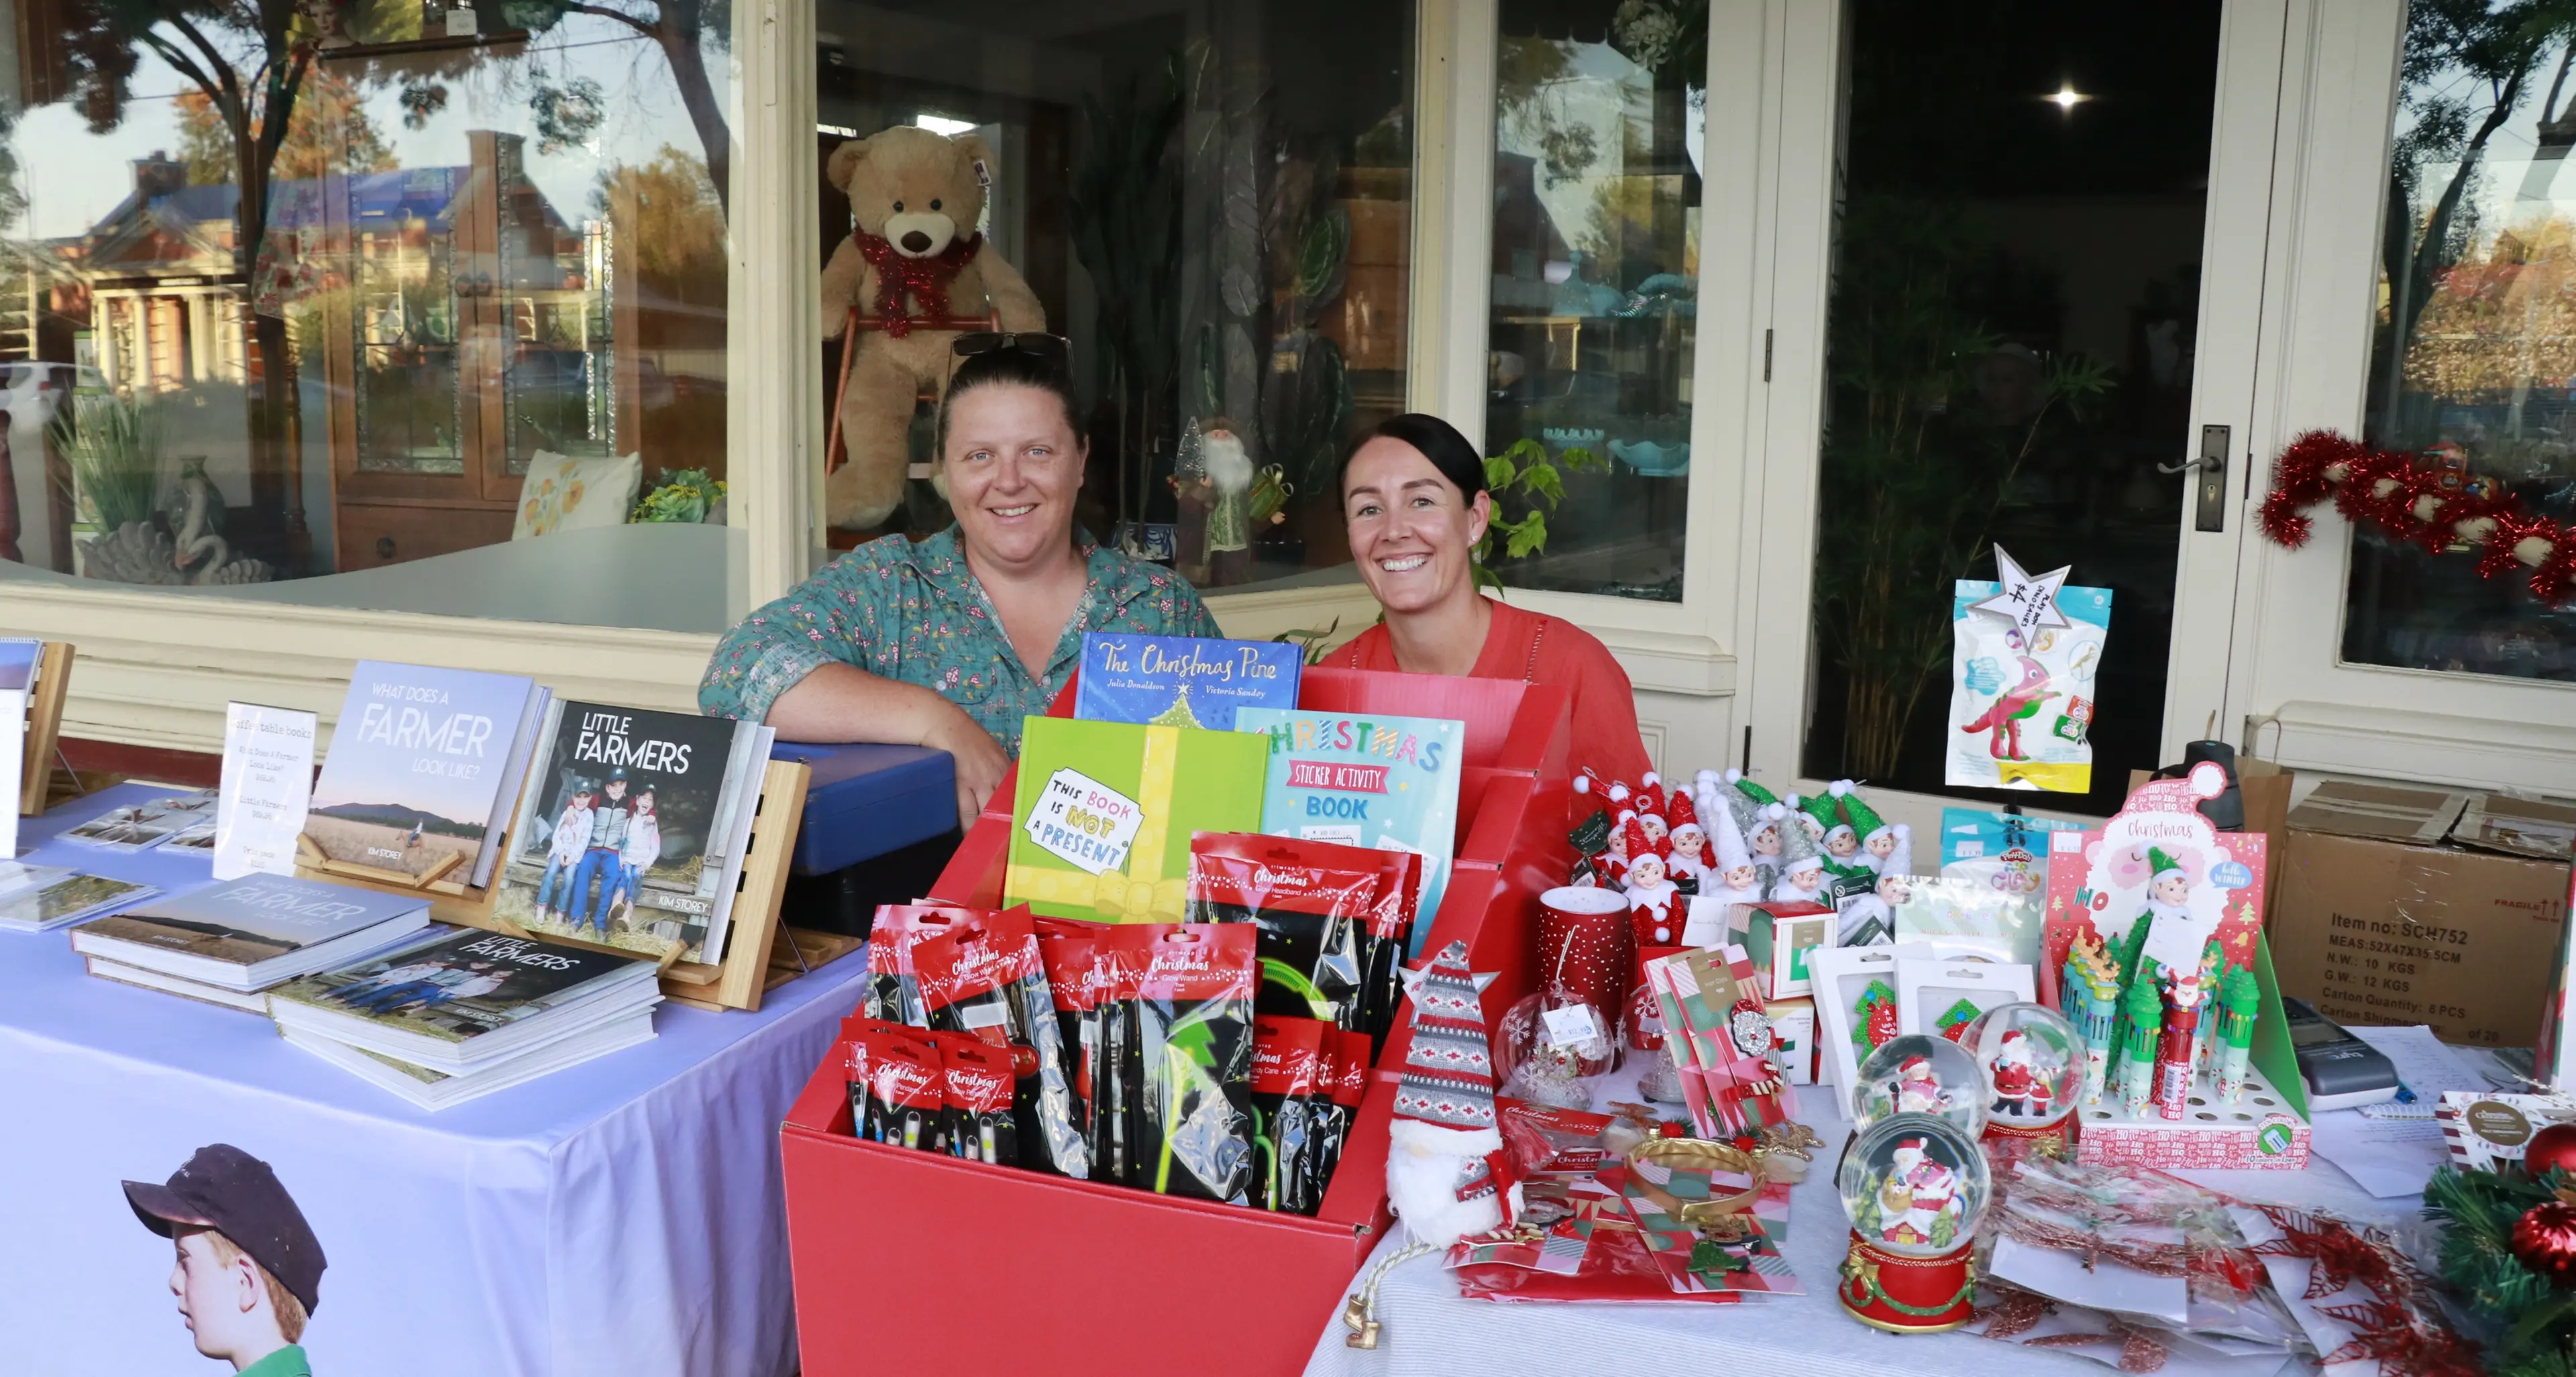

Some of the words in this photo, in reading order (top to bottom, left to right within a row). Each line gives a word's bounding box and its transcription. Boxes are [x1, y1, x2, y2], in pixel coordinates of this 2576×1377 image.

[2008, 583, 2028, 603] $4
[2021, 585, 2045, 627] DINOSAURS
[1099, 642, 1130, 672] The
[1140, 644, 1233, 682] Christmas
[1238, 646, 1277, 679] Pine
[372, 682, 405, 700] WHAT
[406, 687, 439, 704] DOES
[439, 690, 449, 705] A
[1107, 679, 1126, 689] Julia
[1127, 679, 1165, 691] Donaldson
[1205, 685, 1236, 696] Victoria
[260, 723, 285, 735] table
[286, 725, 313, 739] books
[357, 702, 493, 758] FARMER
[582, 712, 633, 735] LITTLE
[574, 731, 692, 775] FARMERS
[1255, 720, 1443, 773] HRISTMAS
[412, 757, 447, 776] LOOK
[448, 765, 480, 781] LIKE?
[1295, 764, 1331, 786] STICKER
[1335, 767, 1382, 789] ACTIVITY
[1053, 779, 1083, 800] THIS
[1086, 790, 1132, 820] BOOK
[1305, 795, 1368, 820] BOOK
[1051, 802, 1063, 814] IS
[1065, 805, 1116, 839] NOT
[2128, 819, 2194, 839] Christmas
[368, 847, 380, 857] KIM
[379, 848, 402, 860] STOREY
[1032, 820, 1040, 830] A
[1040, 823, 1121, 867] PRESENT
[2002, 850, 2032, 863] Play-Doh
[1254, 869, 1308, 886] Christmas
[2214, 872, 2247, 886] WINTER
[2221, 862, 2241, 876] hello
[1255, 885, 1270, 893] Glow
[1271, 887, 1302, 896] Headband
[2074, 885, 2109, 912] HO
[211, 886, 367, 921] FARMER
[658, 895, 675, 907] KIM
[675, 897, 708, 913] STOREY
[2494, 899, 2542, 911] FRAGILE
[2331, 912, 2365, 931] Item
[2371, 923, 2396, 936] no:
[2402, 923, 2468, 946] SCH752
[483, 936, 539, 950] LITTLE
[458, 941, 581, 971] FARMERS
[952, 949, 1000, 975] Christmas
[1151, 956, 1210, 973] Christmas
[2365, 958, 2379, 970] 10
[2387, 961, 2416, 975] KGS
[963, 971, 979, 981] Glow
[1162, 974, 1179, 982] Glow
[1179, 974, 1198, 982] Wand
[2363, 976, 2377, 987] 12
[2383, 979, 2410, 993] KGS
[2322, 987, 2363, 1003] Carton
[2365, 993, 2422, 1013] Quantity:
[2438, 1005, 2466, 1019] PCS
[2320, 1004, 2360, 1021] Carton
[2468, 1029, 2483, 1040] of
[2484, 1030, 2500, 1042] 20
[877, 1063, 928, 1085] Christmas
[948, 1071, 998, 1089] Christmas
[1505, 1107, 1560, 1122] Christmas
